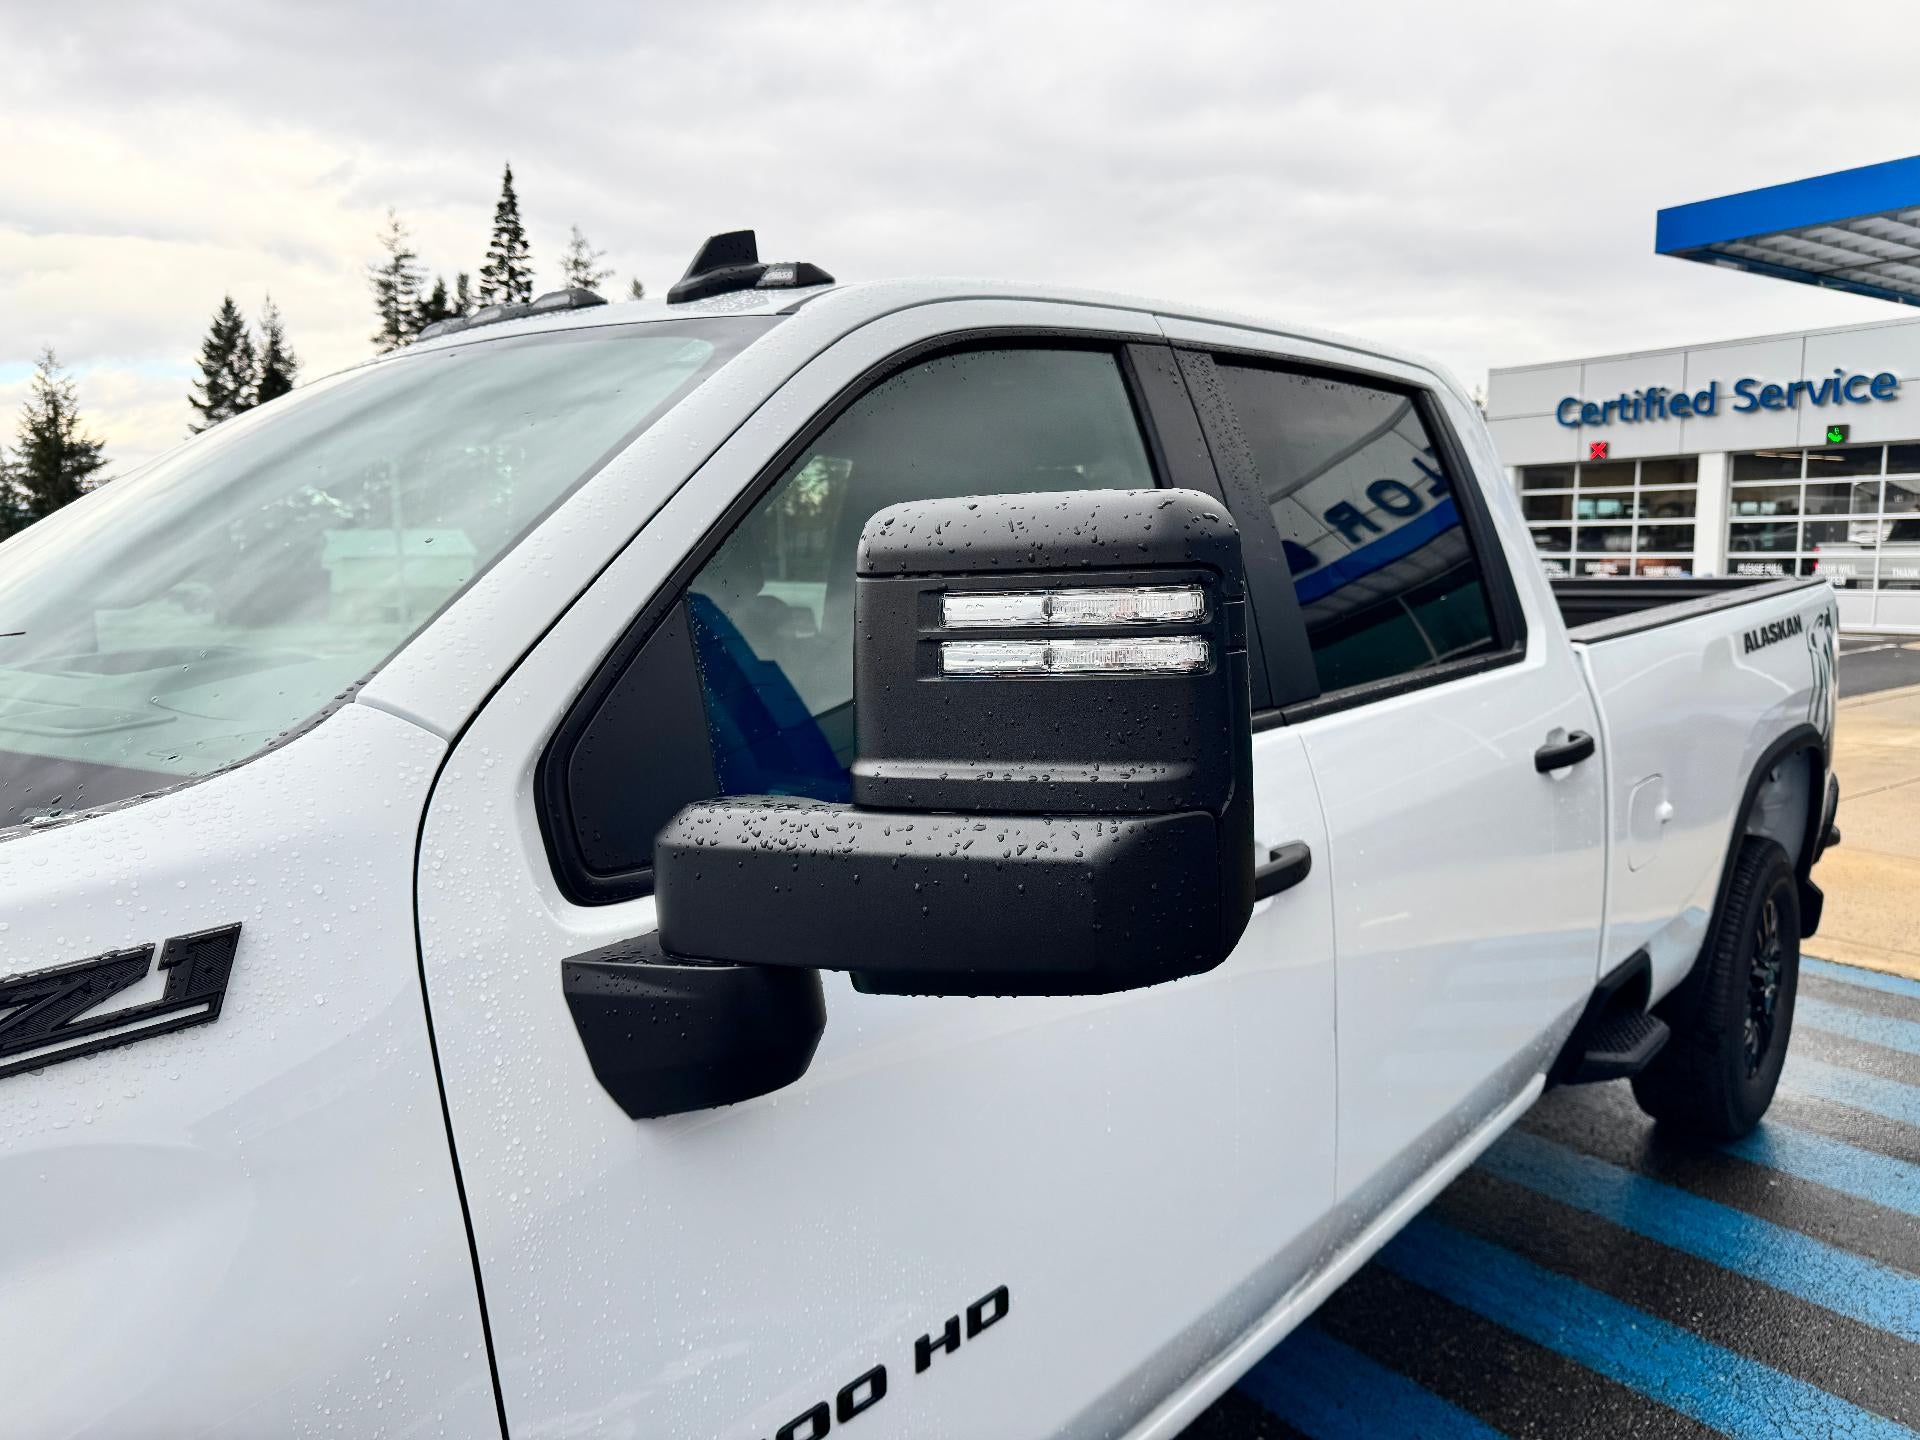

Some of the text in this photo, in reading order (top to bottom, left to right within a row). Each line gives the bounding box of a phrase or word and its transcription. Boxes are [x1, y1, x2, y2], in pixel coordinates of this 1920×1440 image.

[1556, 368, 1900, 428] Certified Service
[1743, 613, 1803, 654] ALASKAN
[760, 1284, 1009, 1440] 00 HD
